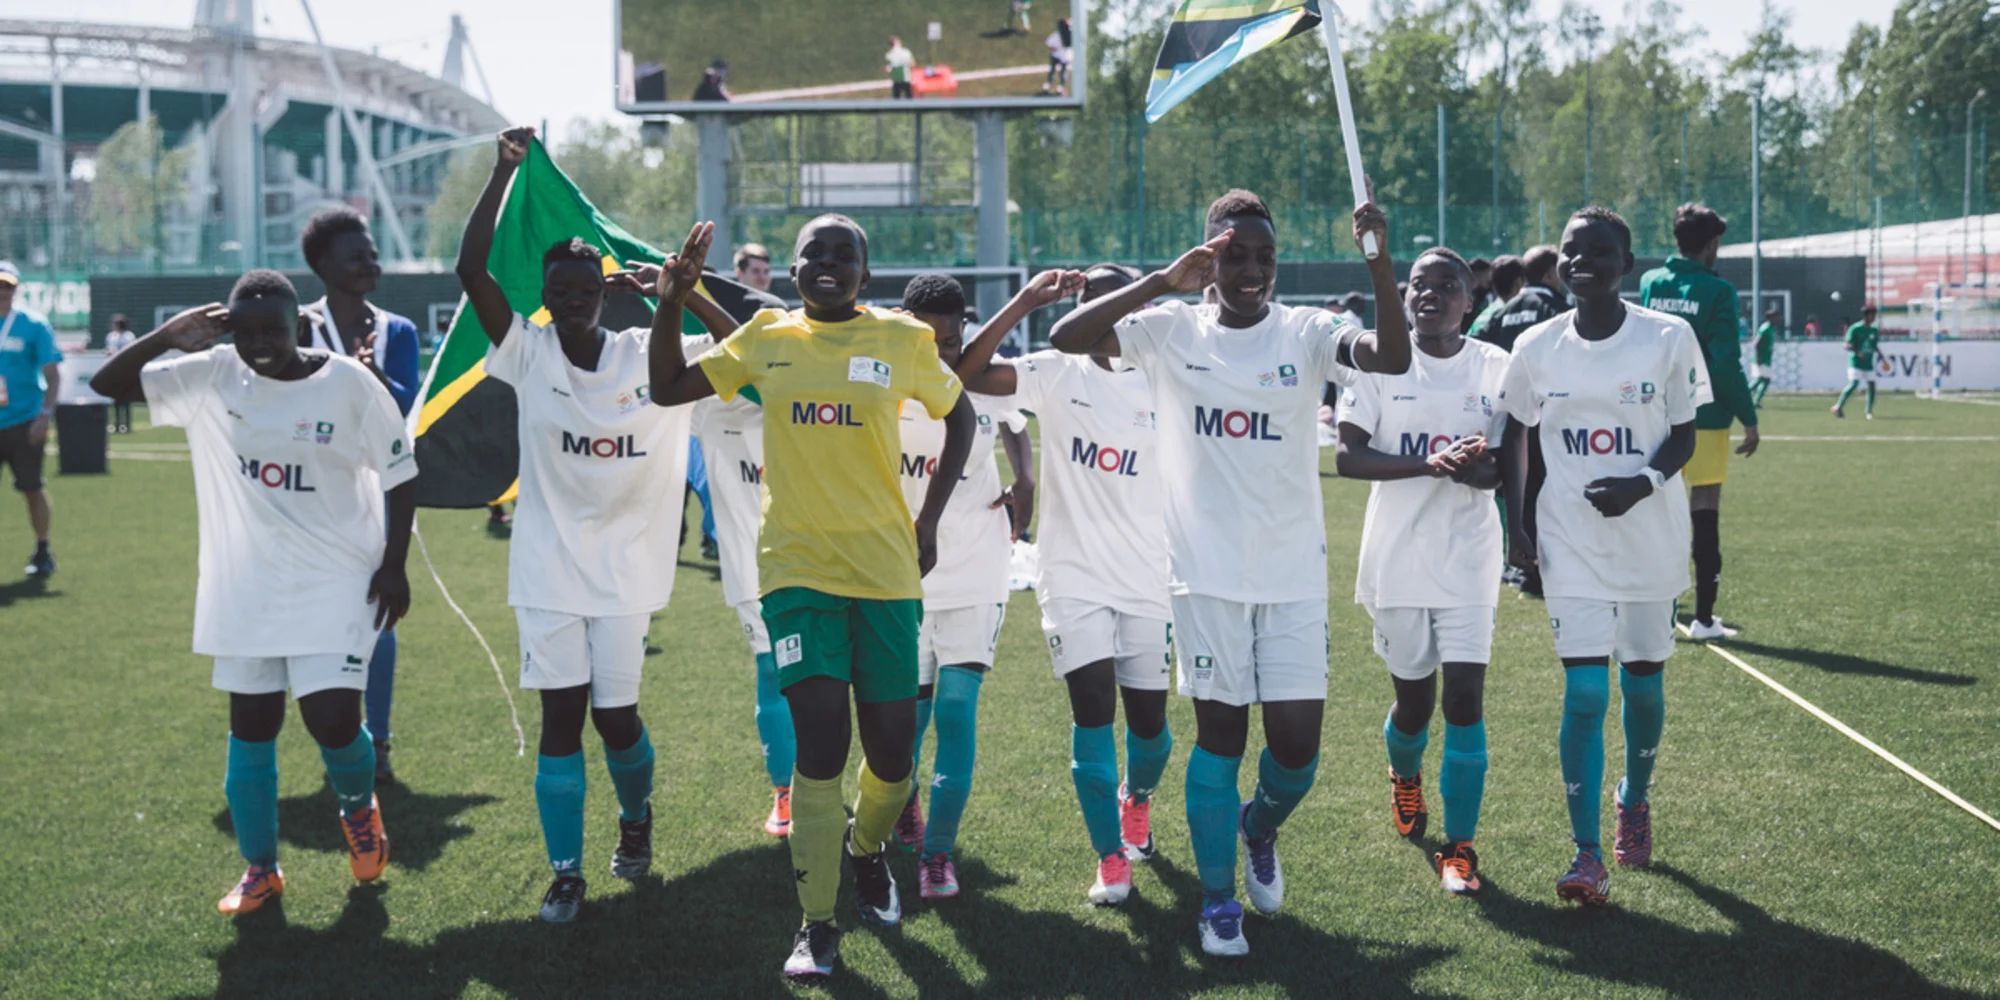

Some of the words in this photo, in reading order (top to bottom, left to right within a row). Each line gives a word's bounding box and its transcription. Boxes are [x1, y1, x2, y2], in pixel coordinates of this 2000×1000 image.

[793, 401, 863, 427] MOIL
[1195, 405, 1282, 441] MOIL
[562, 430, 647, 458] MOIL
[1072, 436, 1139, 476] MOIL
[1400, 432, 1469, 457] MO
[1562, 427, 1645, 457] MOIL
[238, 454, 316, 492] MOIL
